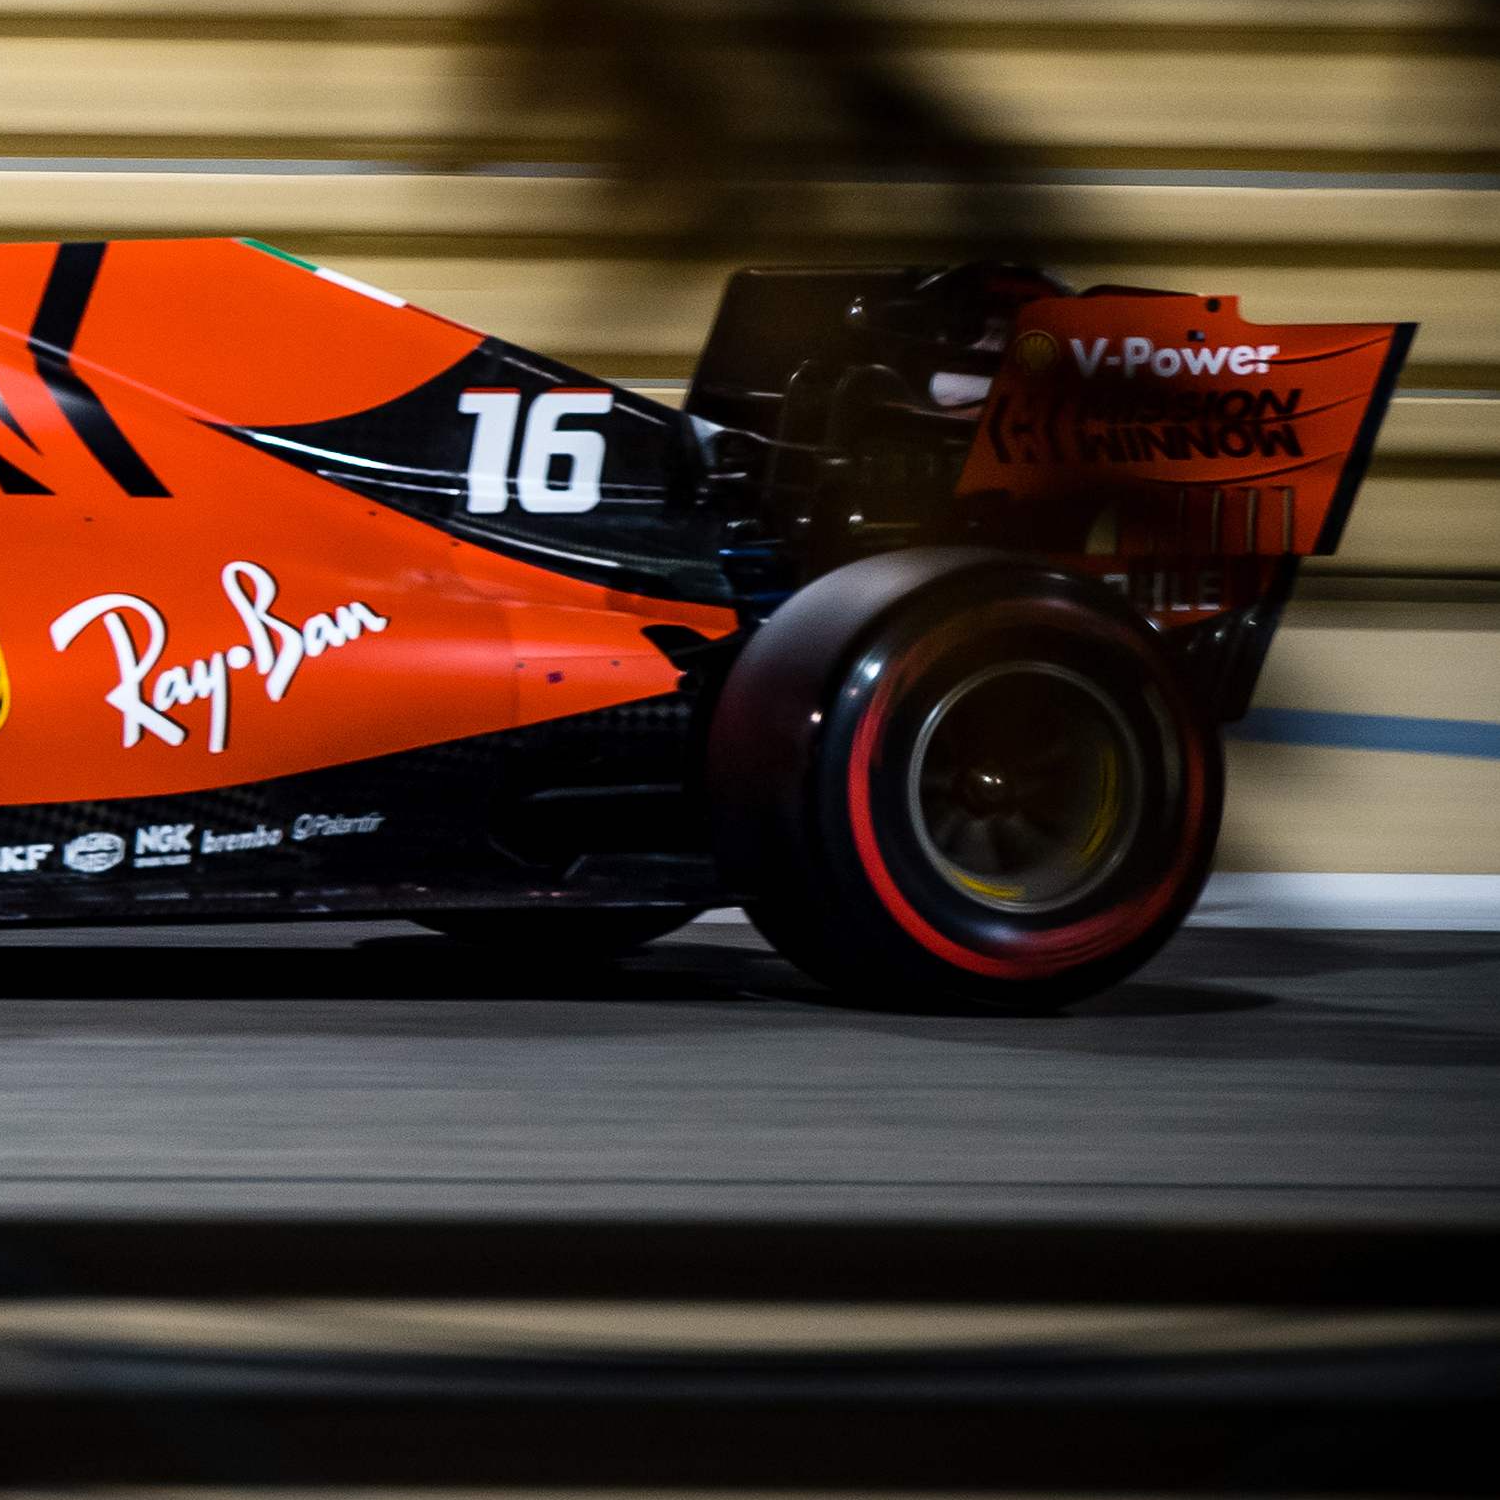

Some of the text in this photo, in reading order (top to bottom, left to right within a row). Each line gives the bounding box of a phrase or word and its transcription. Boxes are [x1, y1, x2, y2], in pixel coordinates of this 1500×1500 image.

[1069, 336, 1280, 378] V-Power
[1083, 388, 1304, 422] SSION
[457, 386, 614, 514] 16
[134, 822, 195, 855] NGK
[200, 823, 284, 855] brembo
